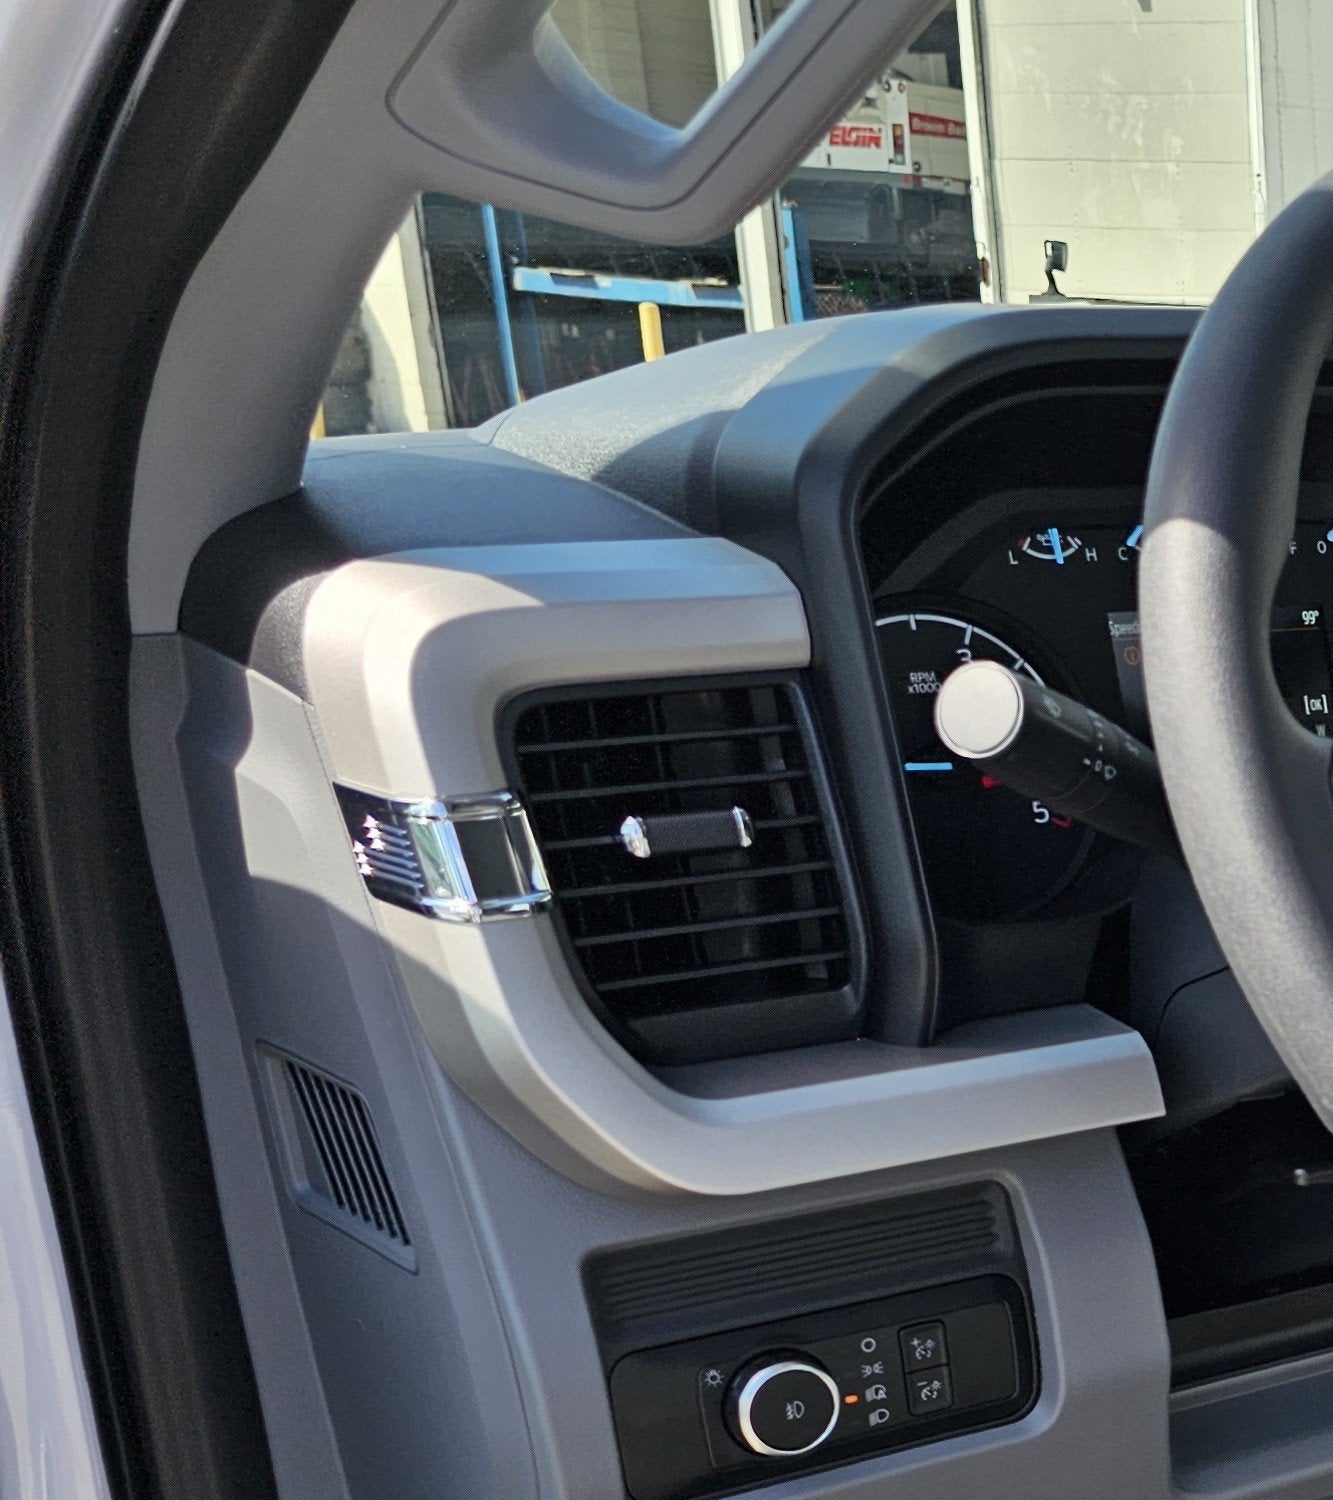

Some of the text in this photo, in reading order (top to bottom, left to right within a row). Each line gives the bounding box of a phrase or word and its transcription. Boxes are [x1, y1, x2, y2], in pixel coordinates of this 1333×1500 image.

[829, 125, 882, 149] ELGIN
[1085, 547, 1098, 562] H
[909, 671, 937, 684] RPM
[1032, 800, 1050, 824] 5
